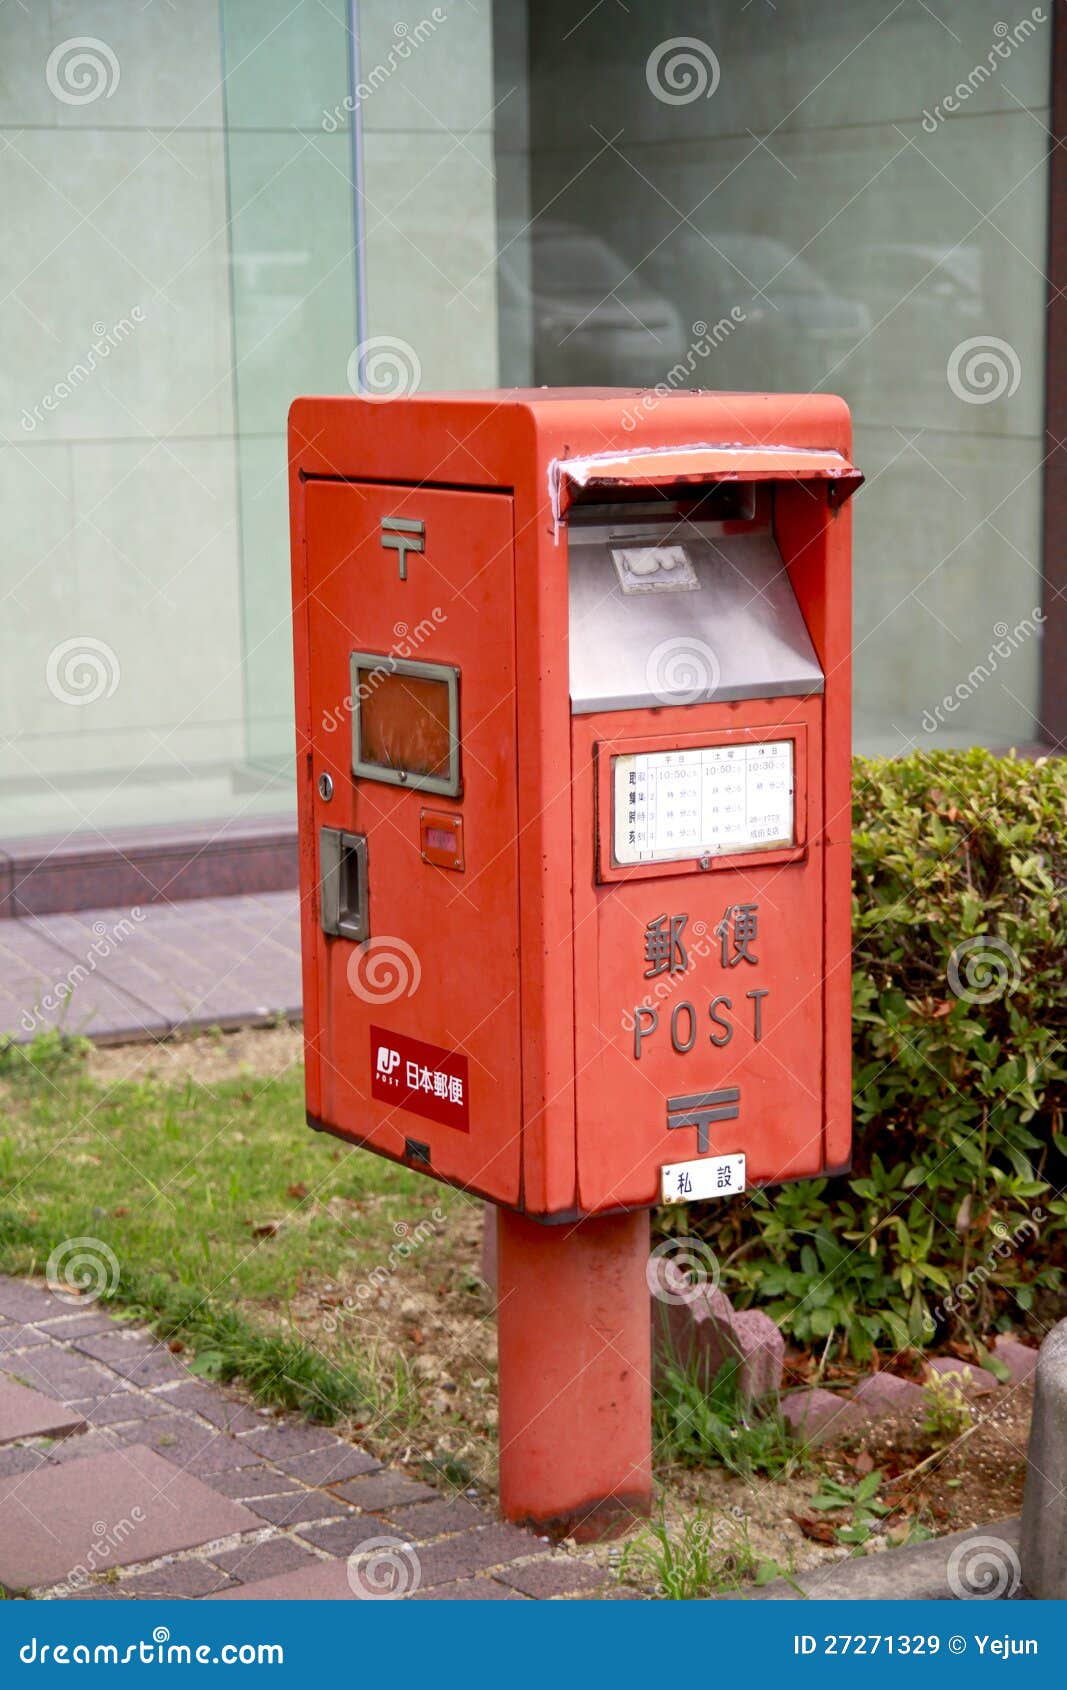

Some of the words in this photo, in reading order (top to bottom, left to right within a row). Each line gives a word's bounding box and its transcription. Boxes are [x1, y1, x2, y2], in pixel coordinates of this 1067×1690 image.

[643, 903, 759, 977] 郵便
[634, 989, 769, 1059] POST
[375, 1072, 399, 1087] POST
[406, 1060, 463, 1106] 日本郵便
[677, 1165, 732, 1194] 私設
